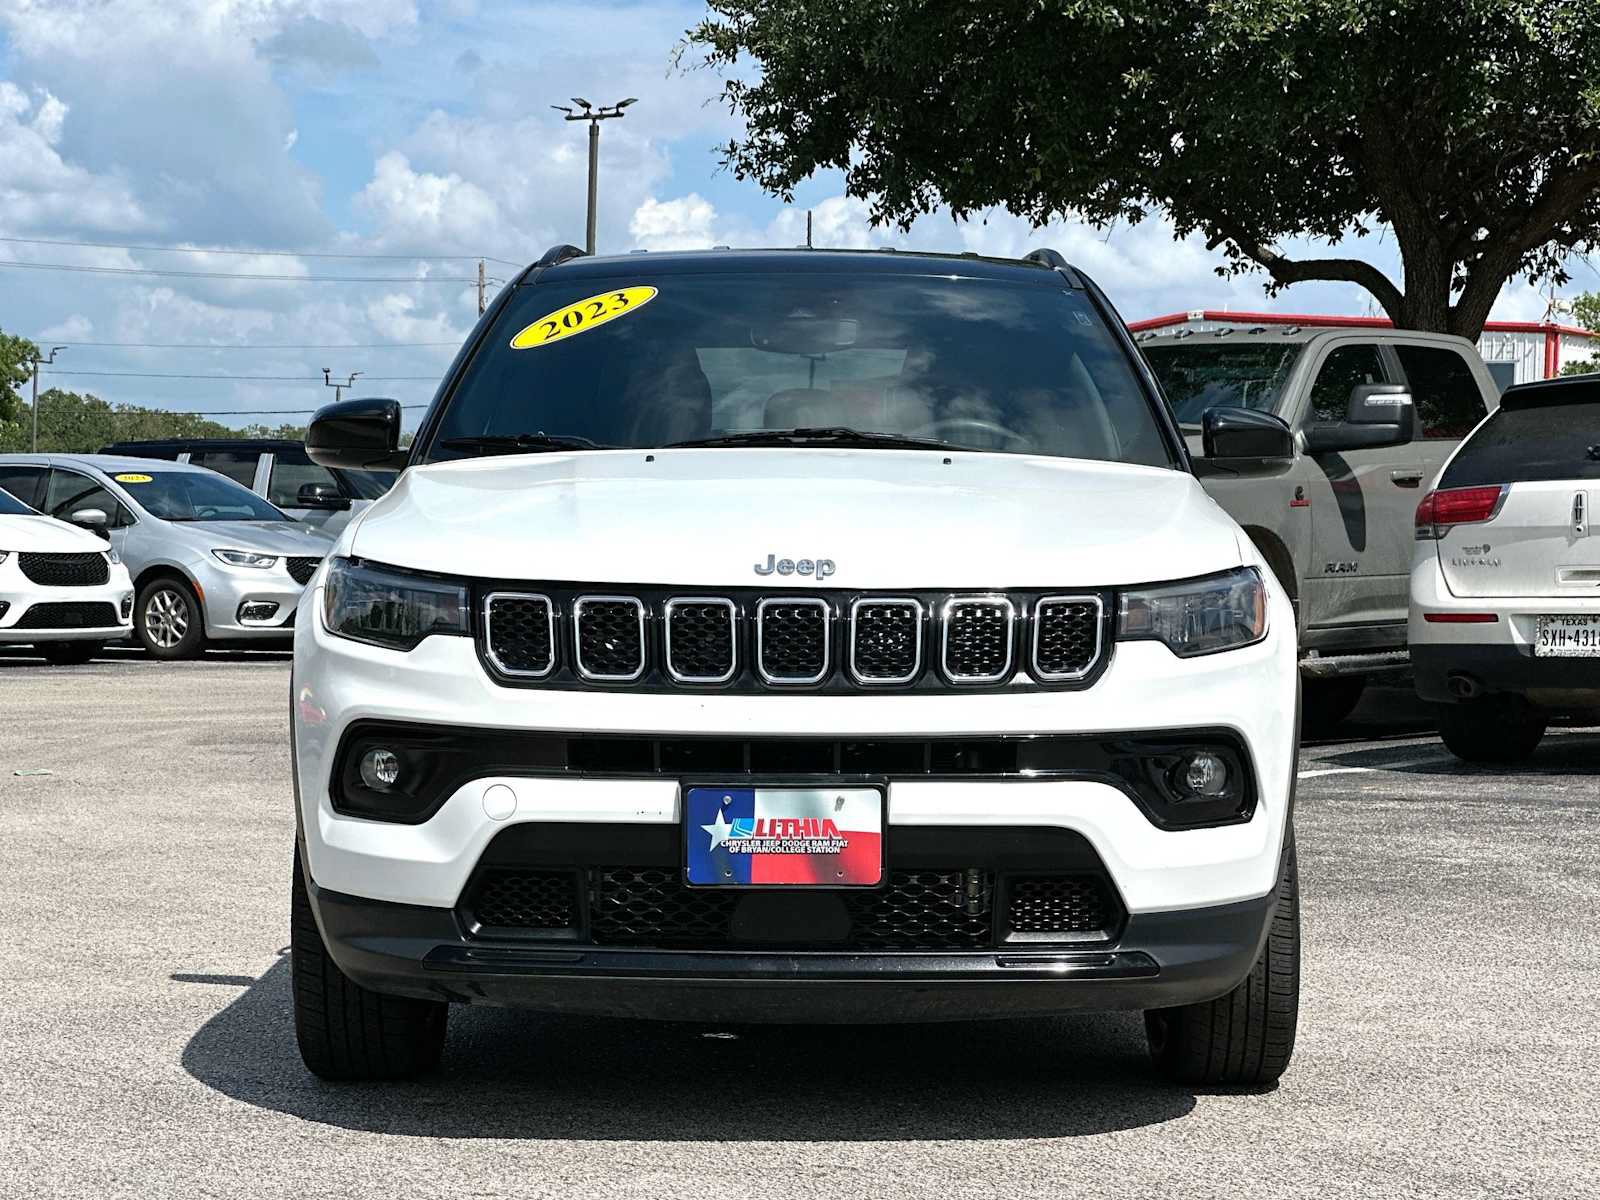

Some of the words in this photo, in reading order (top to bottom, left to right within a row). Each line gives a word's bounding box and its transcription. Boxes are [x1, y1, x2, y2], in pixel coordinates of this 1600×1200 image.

[540, 292, 629, 340] 2023
[754, 553, 836, 581] Jeep
[1324, 562, 1358, 573] RAM
[1561, 617, 1588, 626] TEXAS
[755, 818, 842, 837] LITHIA
